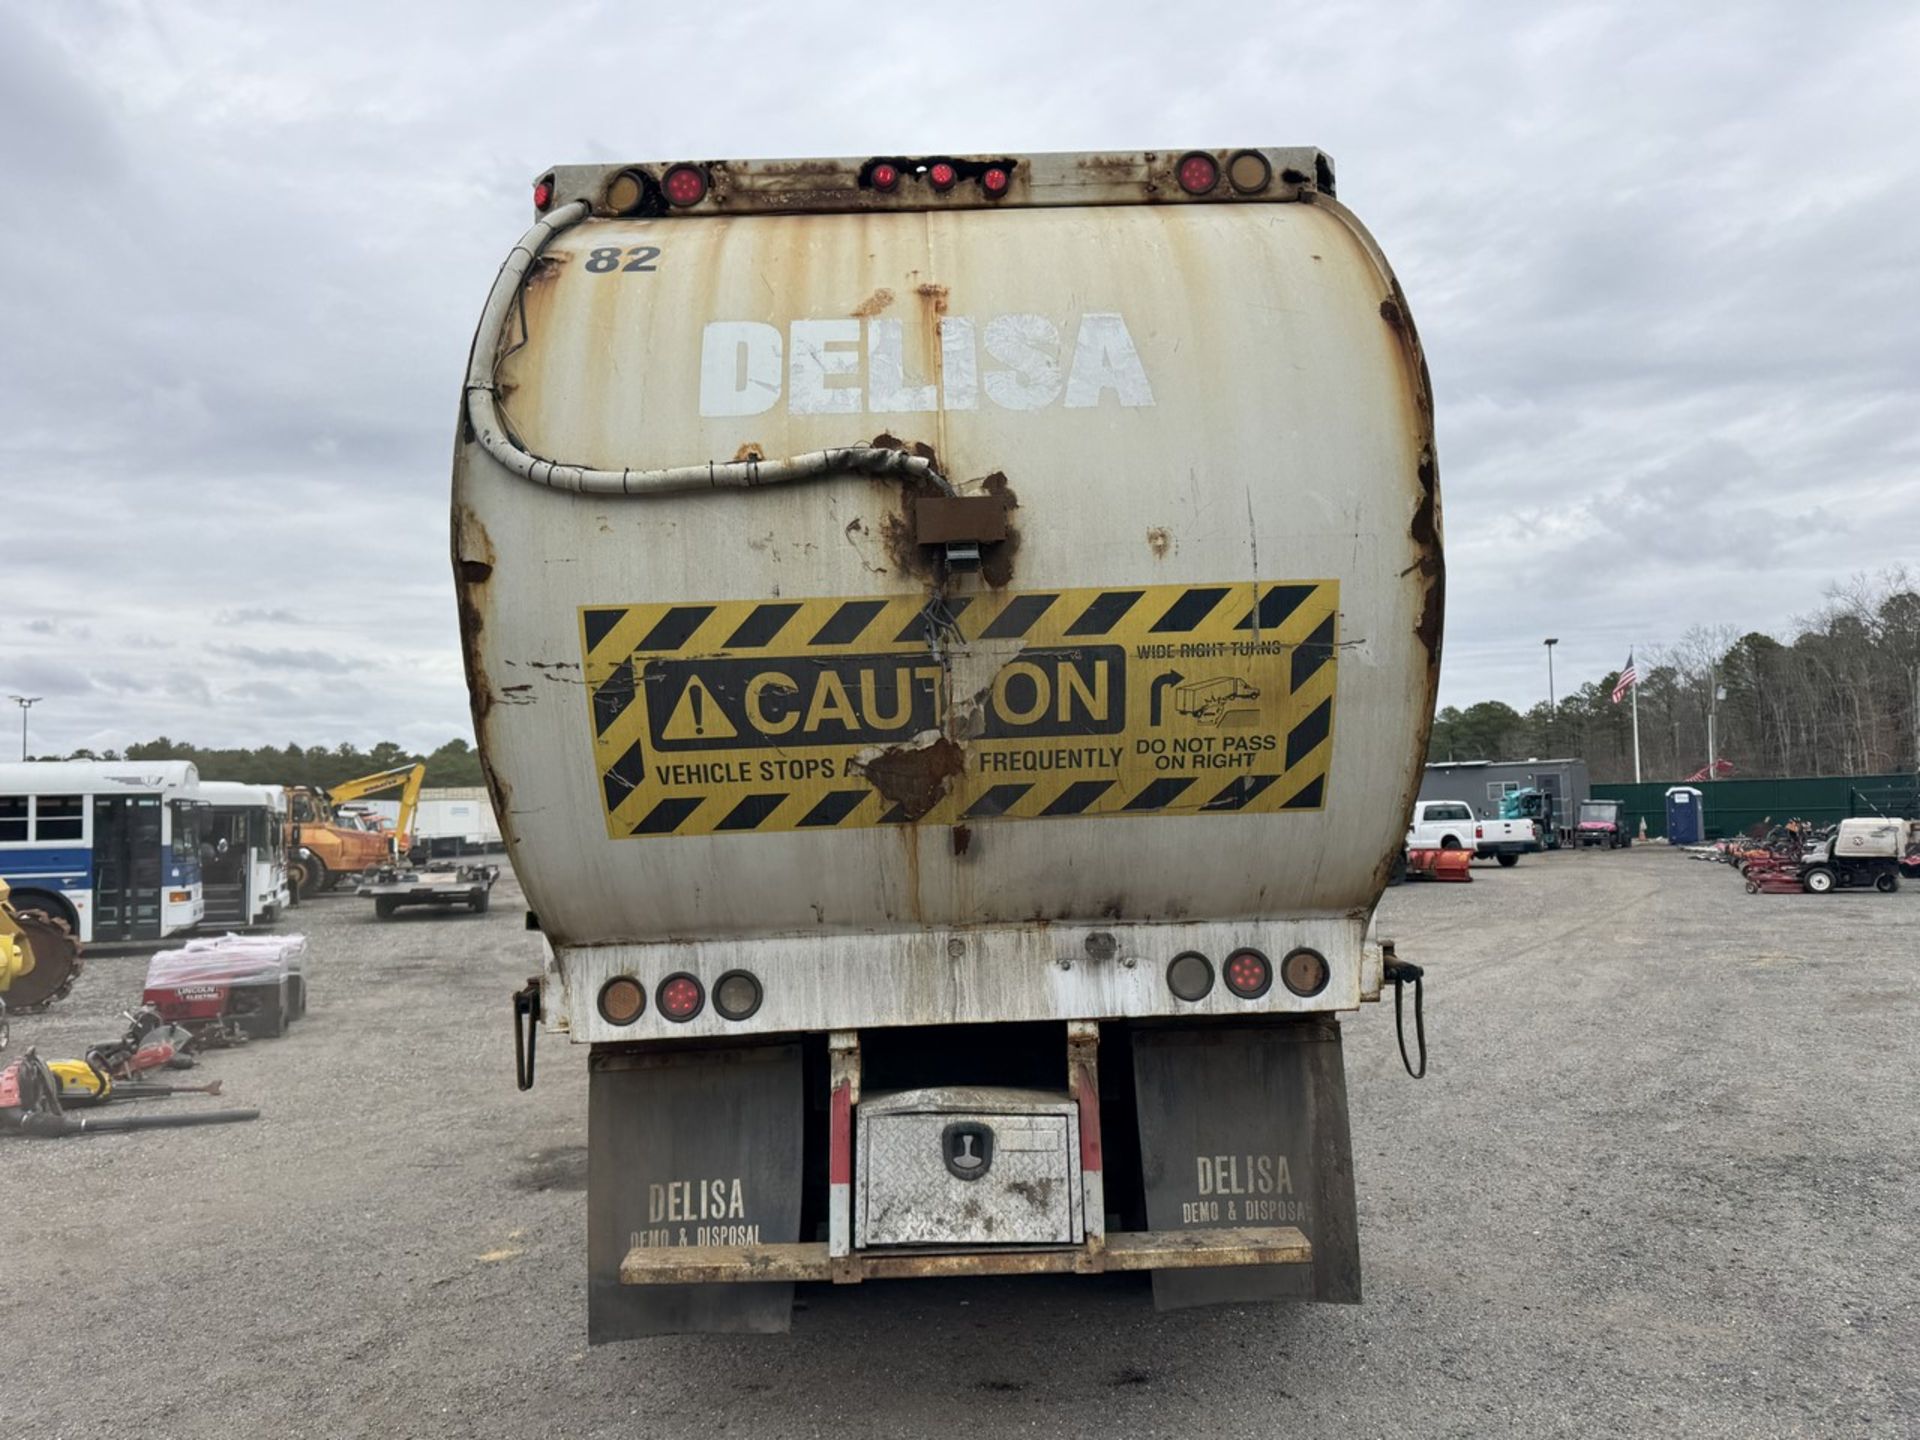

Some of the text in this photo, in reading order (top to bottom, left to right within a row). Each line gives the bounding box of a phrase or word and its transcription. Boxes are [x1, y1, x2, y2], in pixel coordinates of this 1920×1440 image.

[584, 246, 661, 273] 82
[699, 312, 1156, 417] DELISA
[1136, 644, 1175, 660] WIDE
[1180, 642, 1226, 659] RIGHT
[744, 659, 1109, 736] CAUTON
[1136, 735, 1277, 755] DO NOT PASS
[656, 761, 752, 786] VEHICLE
[761, 758, 835, 781] STOPS
[979, 747, 1124, 773] FREQUENTLY
[1155, 752, 1256, 770] ON RIGHT
[1197, 1155, 1293, 1195] DELISA
[649, 1178, 745, 1223] DELISA
[1183, 1202, 1219, 1224] DEMO
[1228, 1201, 1237, 1220] &
[697, 1224, 762, 1247] DISPOSAL
